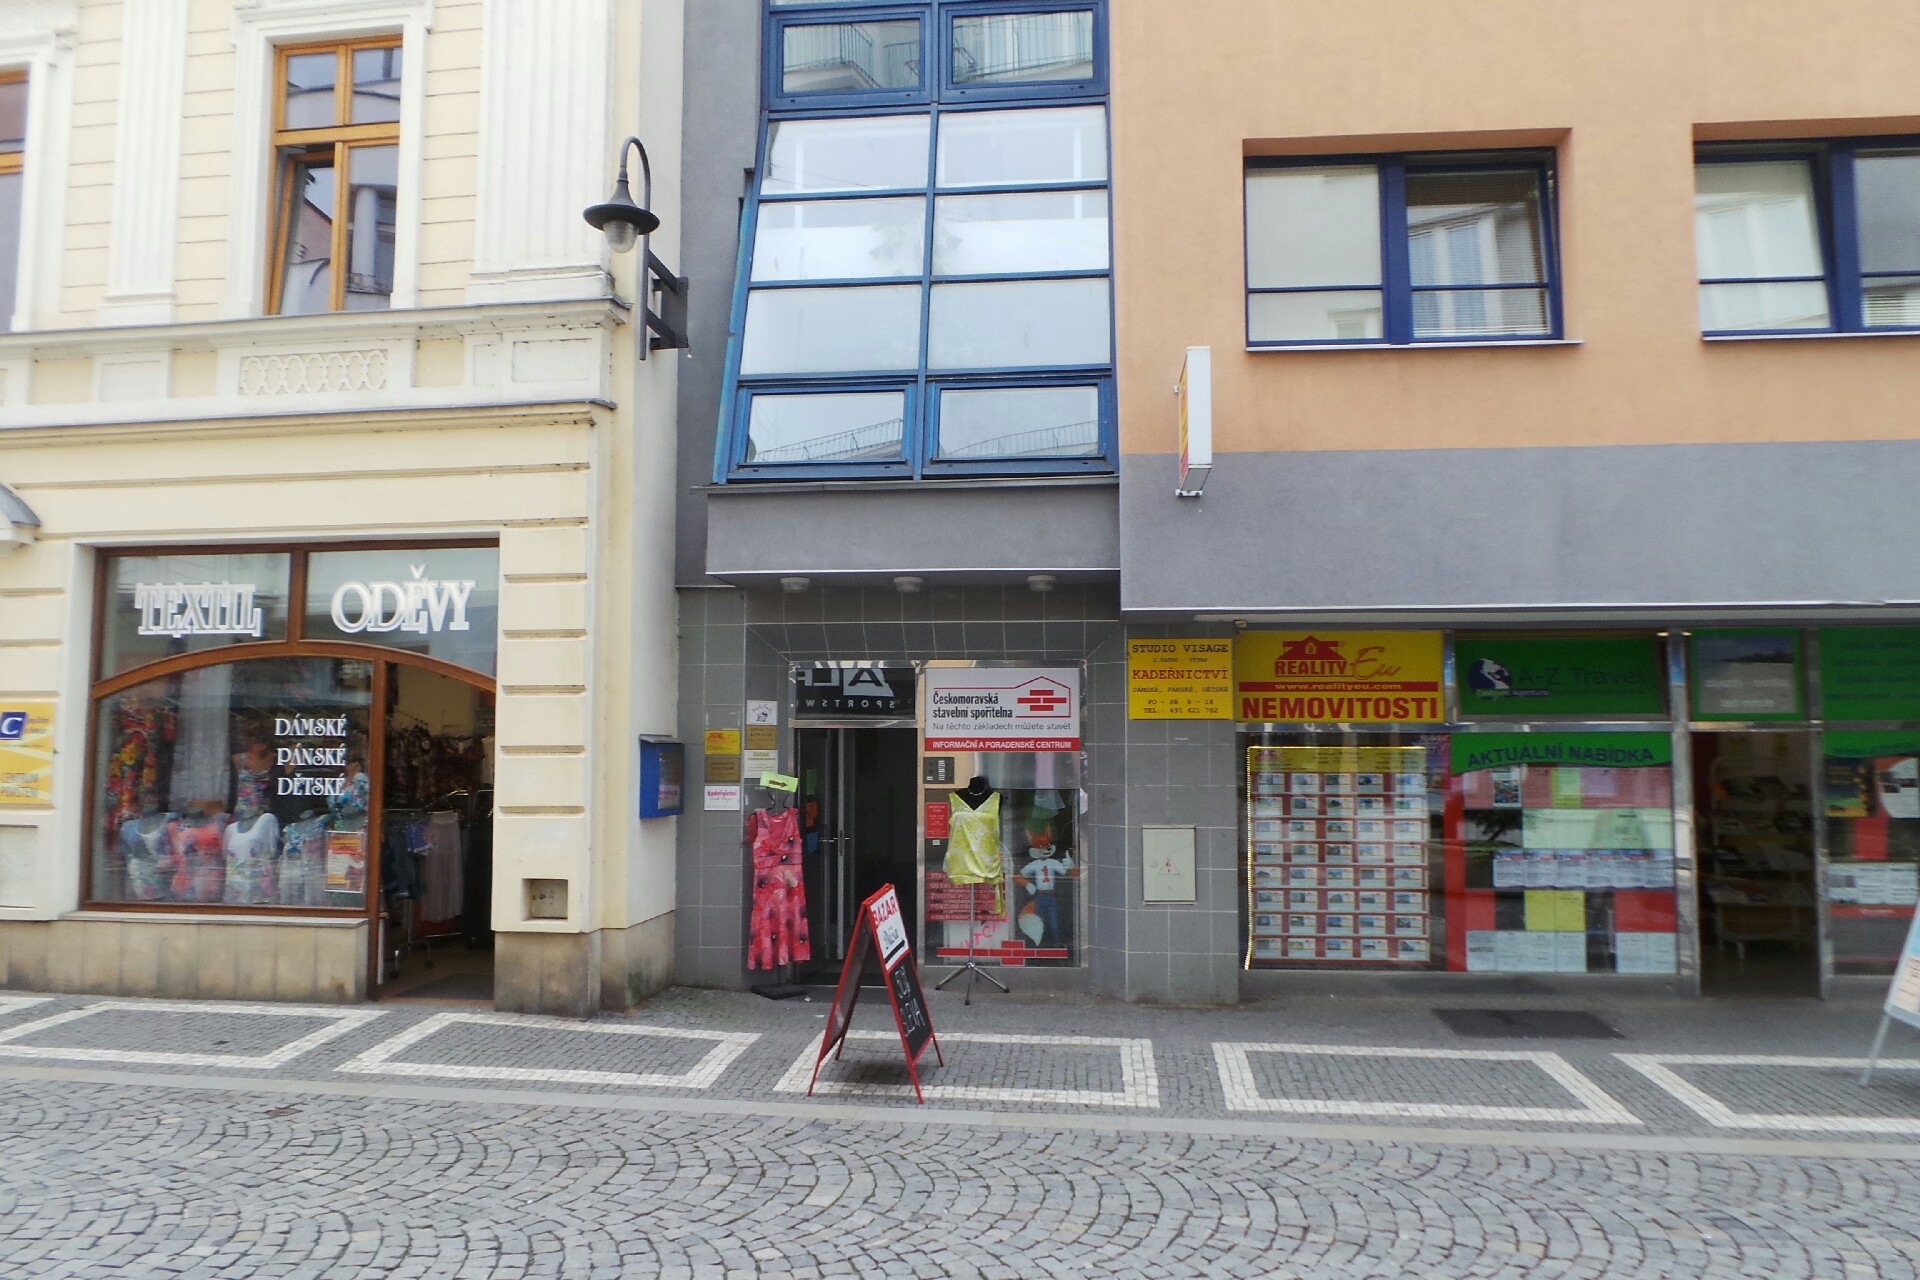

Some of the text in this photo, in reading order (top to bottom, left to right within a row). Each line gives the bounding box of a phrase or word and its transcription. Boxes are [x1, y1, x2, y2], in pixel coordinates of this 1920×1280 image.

[330, 564, 475, 634] ODĚVY
[134, 582, 263, 638] TEXTIL
[1132, 644, 1229, 653] STUDIO VISAGE
[1132, 667, 1229, 680] KADEŘNICTVÍ
[1274, 661, 1348, 675] REALITY
[1520, 668, 1562, 685] A-Z
[1274, 683, 1403, 691] www.realityeu.com
[933, 691, 999, 705] Českomoravská
[932, 705, 1013, 720] stavební spořitelna
[1242, 697, 1438, 719] NEMOVITOSTI
[274, 713, 347, 736] DÁMSKÉ
[946, 722, 971, 730] těchto
[973, 722, 1013, 730] základech
[1015, 722, 1044, 730] můžete
[1046, 722, 1071, 730] stavět
[932, 740, 1072, 749] INFORMAČNÍ A PORADENSKÉ CENTRUM
[276, 743, 346, 766] PÁNSKÉ
[1468, 743, 1563, 767] AKTUÁLNÍ
[1569, 745, 1654, 763] NABÍDKA
[277, 773, 345, 796] DĚTSKÉ
[873, 895, 897, 929] BAZAR
